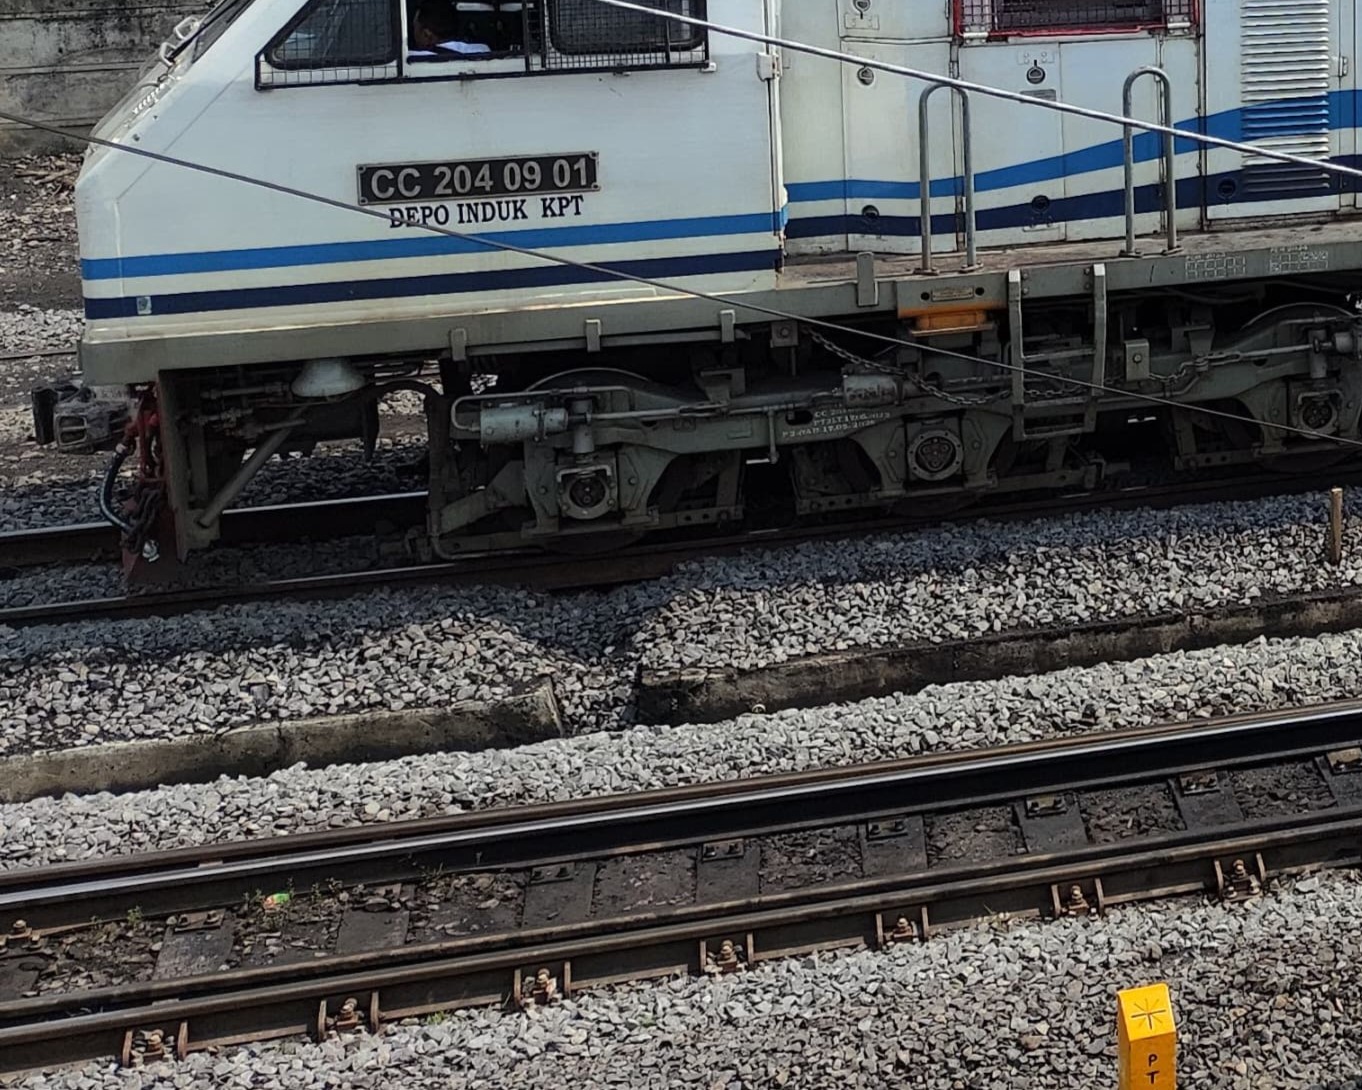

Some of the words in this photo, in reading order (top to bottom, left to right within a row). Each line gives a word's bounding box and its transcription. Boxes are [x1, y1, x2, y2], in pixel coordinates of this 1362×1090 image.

[370, 167, 422, 199] CC
[433, 163, 494, 196] 204
[503, 160, 543, 191] 09
[552, 157, 589, 187] 01
[389, 205, 449, 229] DEPO
[457, 198, 528, 224] INDUK
[540, 194, 584, 218] KPT
